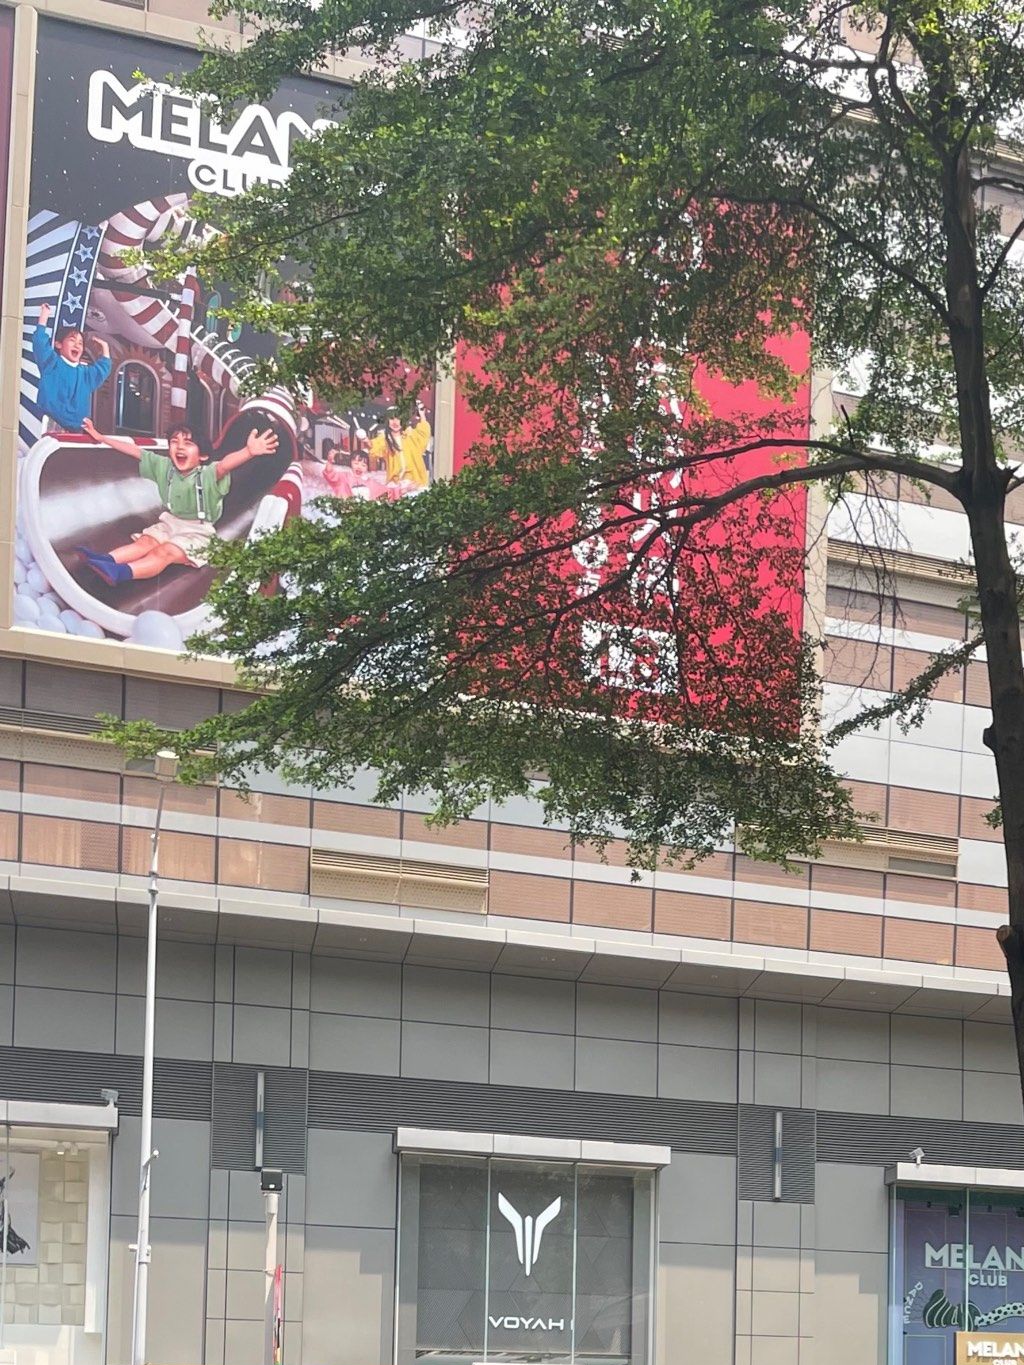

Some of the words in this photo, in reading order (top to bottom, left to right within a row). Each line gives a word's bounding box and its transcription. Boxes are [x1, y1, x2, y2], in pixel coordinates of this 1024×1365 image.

[968, 1273, 1008, 1287] CLUB
[903, 1281, 924, 1325] DANCE
[488, 1316, 564, 1331] VOYAH
